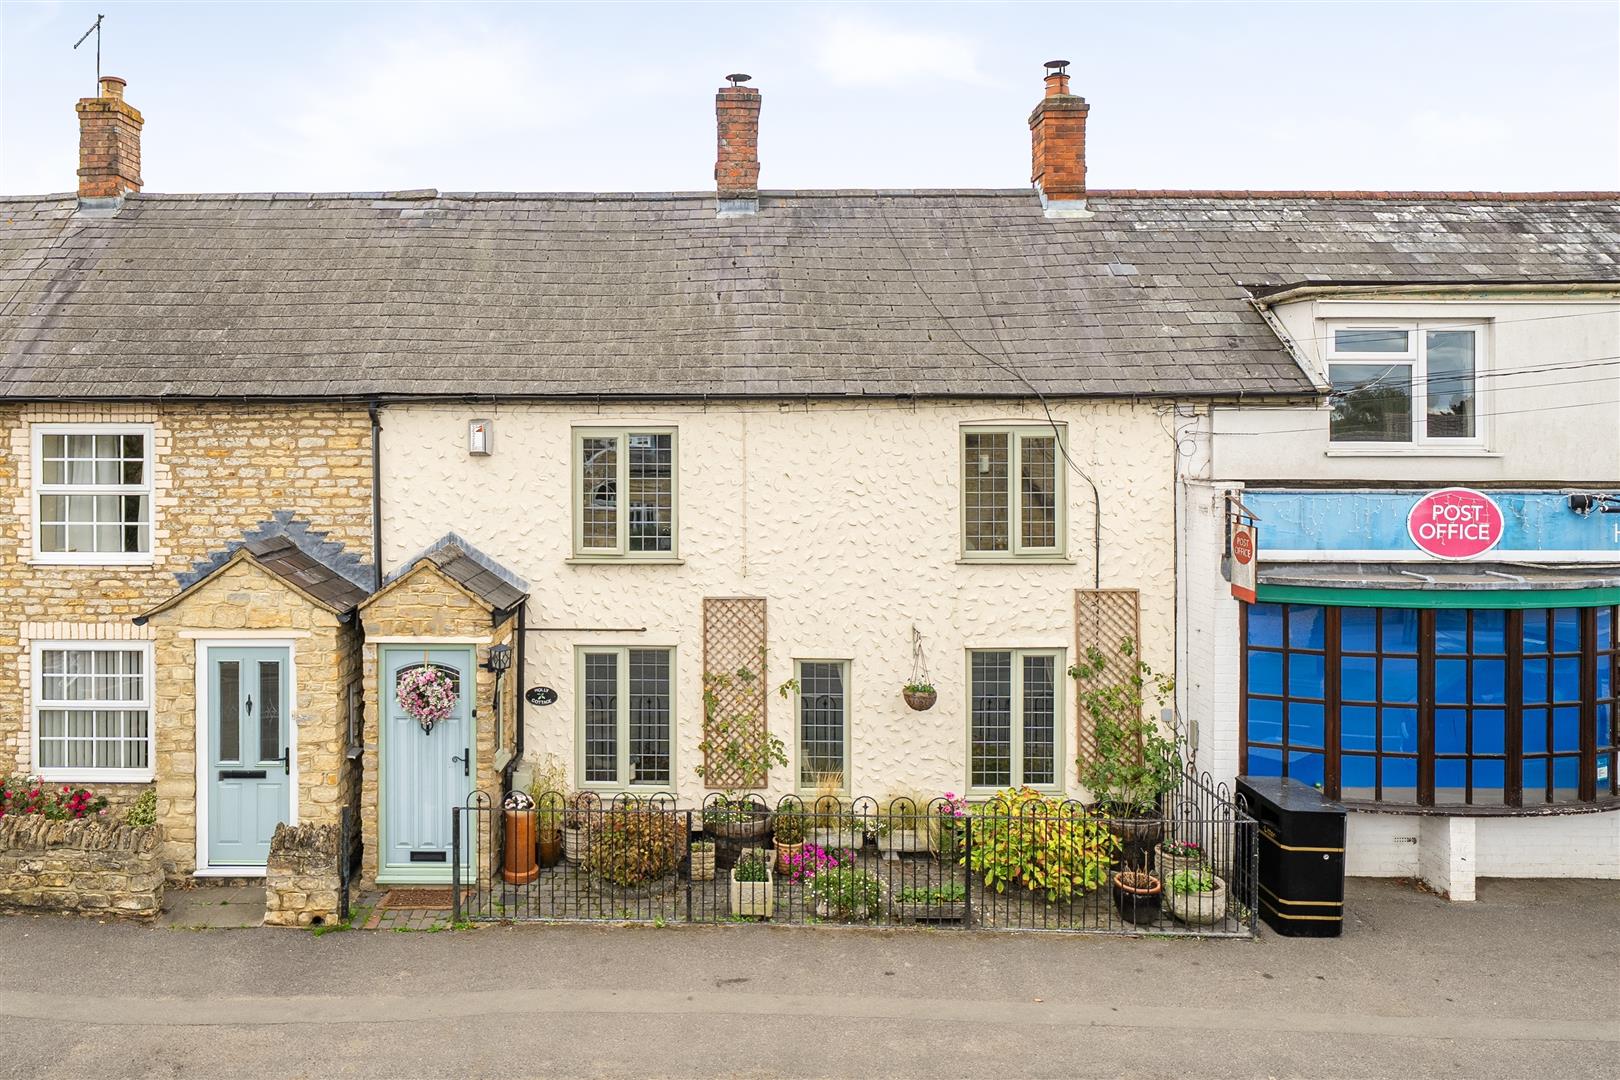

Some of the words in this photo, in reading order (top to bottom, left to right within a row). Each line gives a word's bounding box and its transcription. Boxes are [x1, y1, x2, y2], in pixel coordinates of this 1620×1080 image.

[1432, 504, 1484, 521] POST
[1419, 523, 1490, 540] OFFICE
[1236, 536, 1250, 547] POST
[1235, 546, 1251, 558] OFFICE
